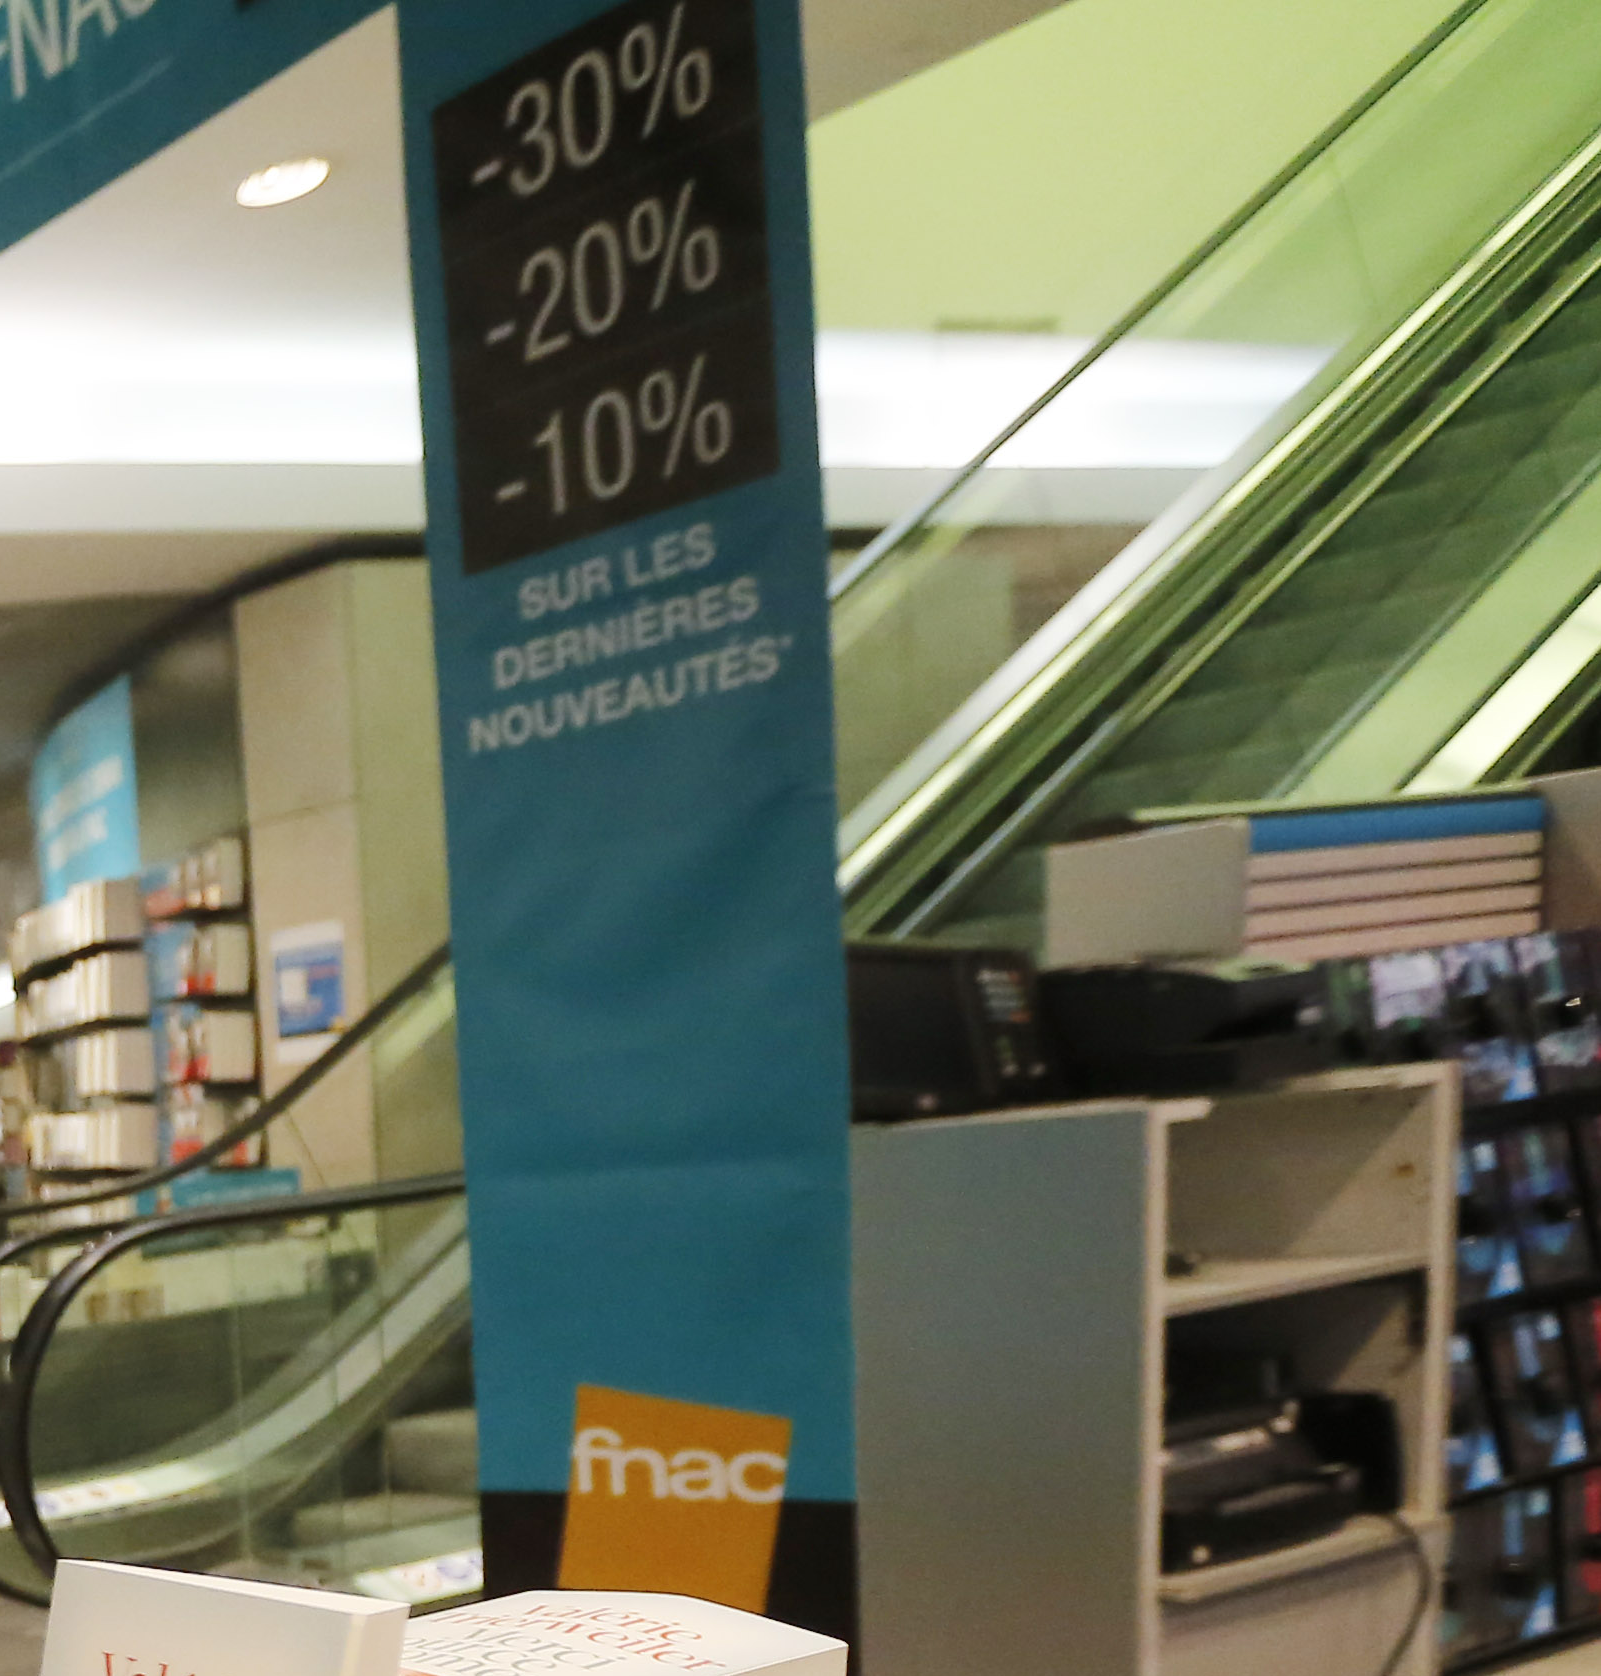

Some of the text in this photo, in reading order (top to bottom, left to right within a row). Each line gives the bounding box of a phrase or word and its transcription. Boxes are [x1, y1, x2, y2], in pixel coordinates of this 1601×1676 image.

[473, 2, 711, 196] -30%
[486, 179, 720, 364] -20%
[497, 355, 732, 516] -10%
[517, 523, 716, 621] SUR LES
[492, 577, 760, 691] DERNIÈRES
[572, 1426, 789, 1504] fnac
[524, 1604, 703, 1643] Valérie
